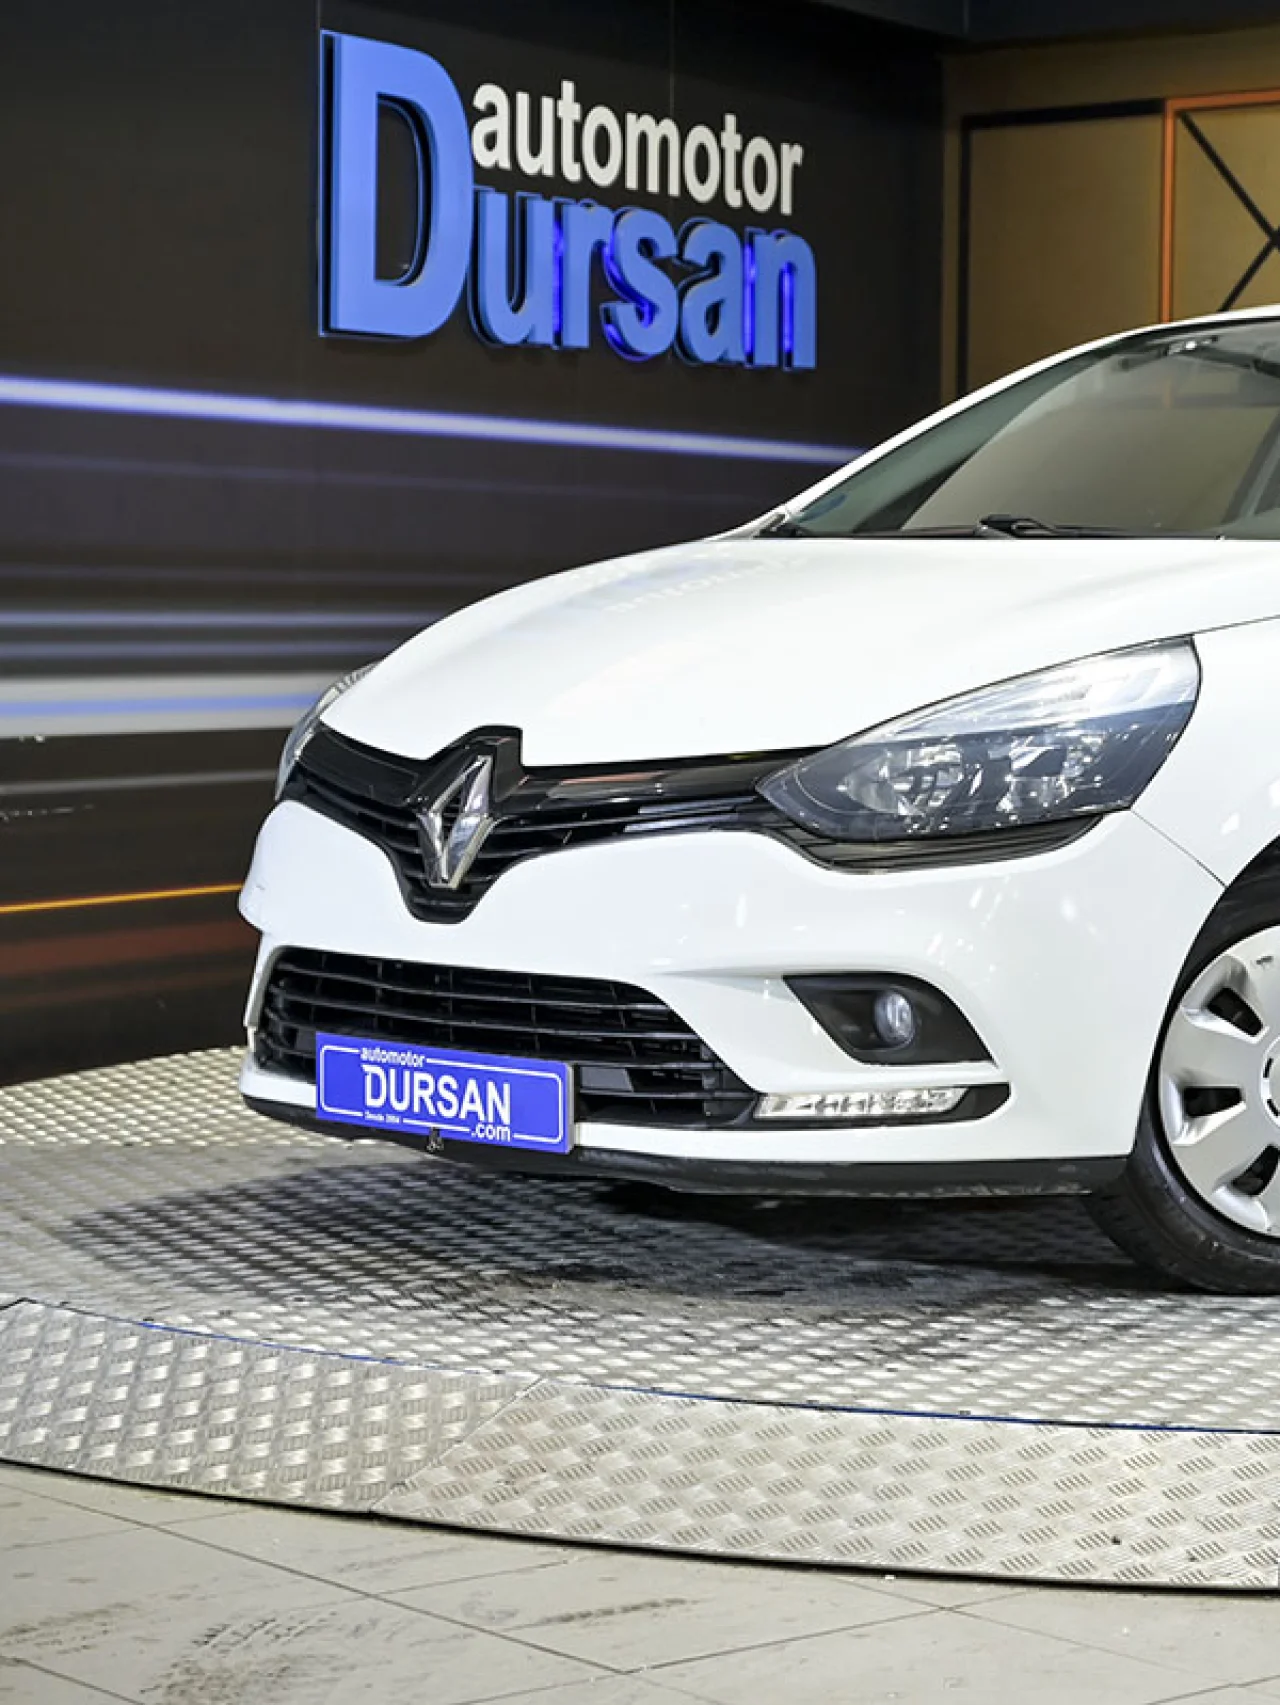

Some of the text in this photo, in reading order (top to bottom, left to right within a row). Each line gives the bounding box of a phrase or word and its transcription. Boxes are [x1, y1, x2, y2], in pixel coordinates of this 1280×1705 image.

[471, 80, 803, 216] automotor
[319, 29, 817, 371] Dursan
[360, 1047, 426, 1068] automotor
[361, 1064, 511, 1126] DURSAN
[471, 1122, 511, 1142] .com
